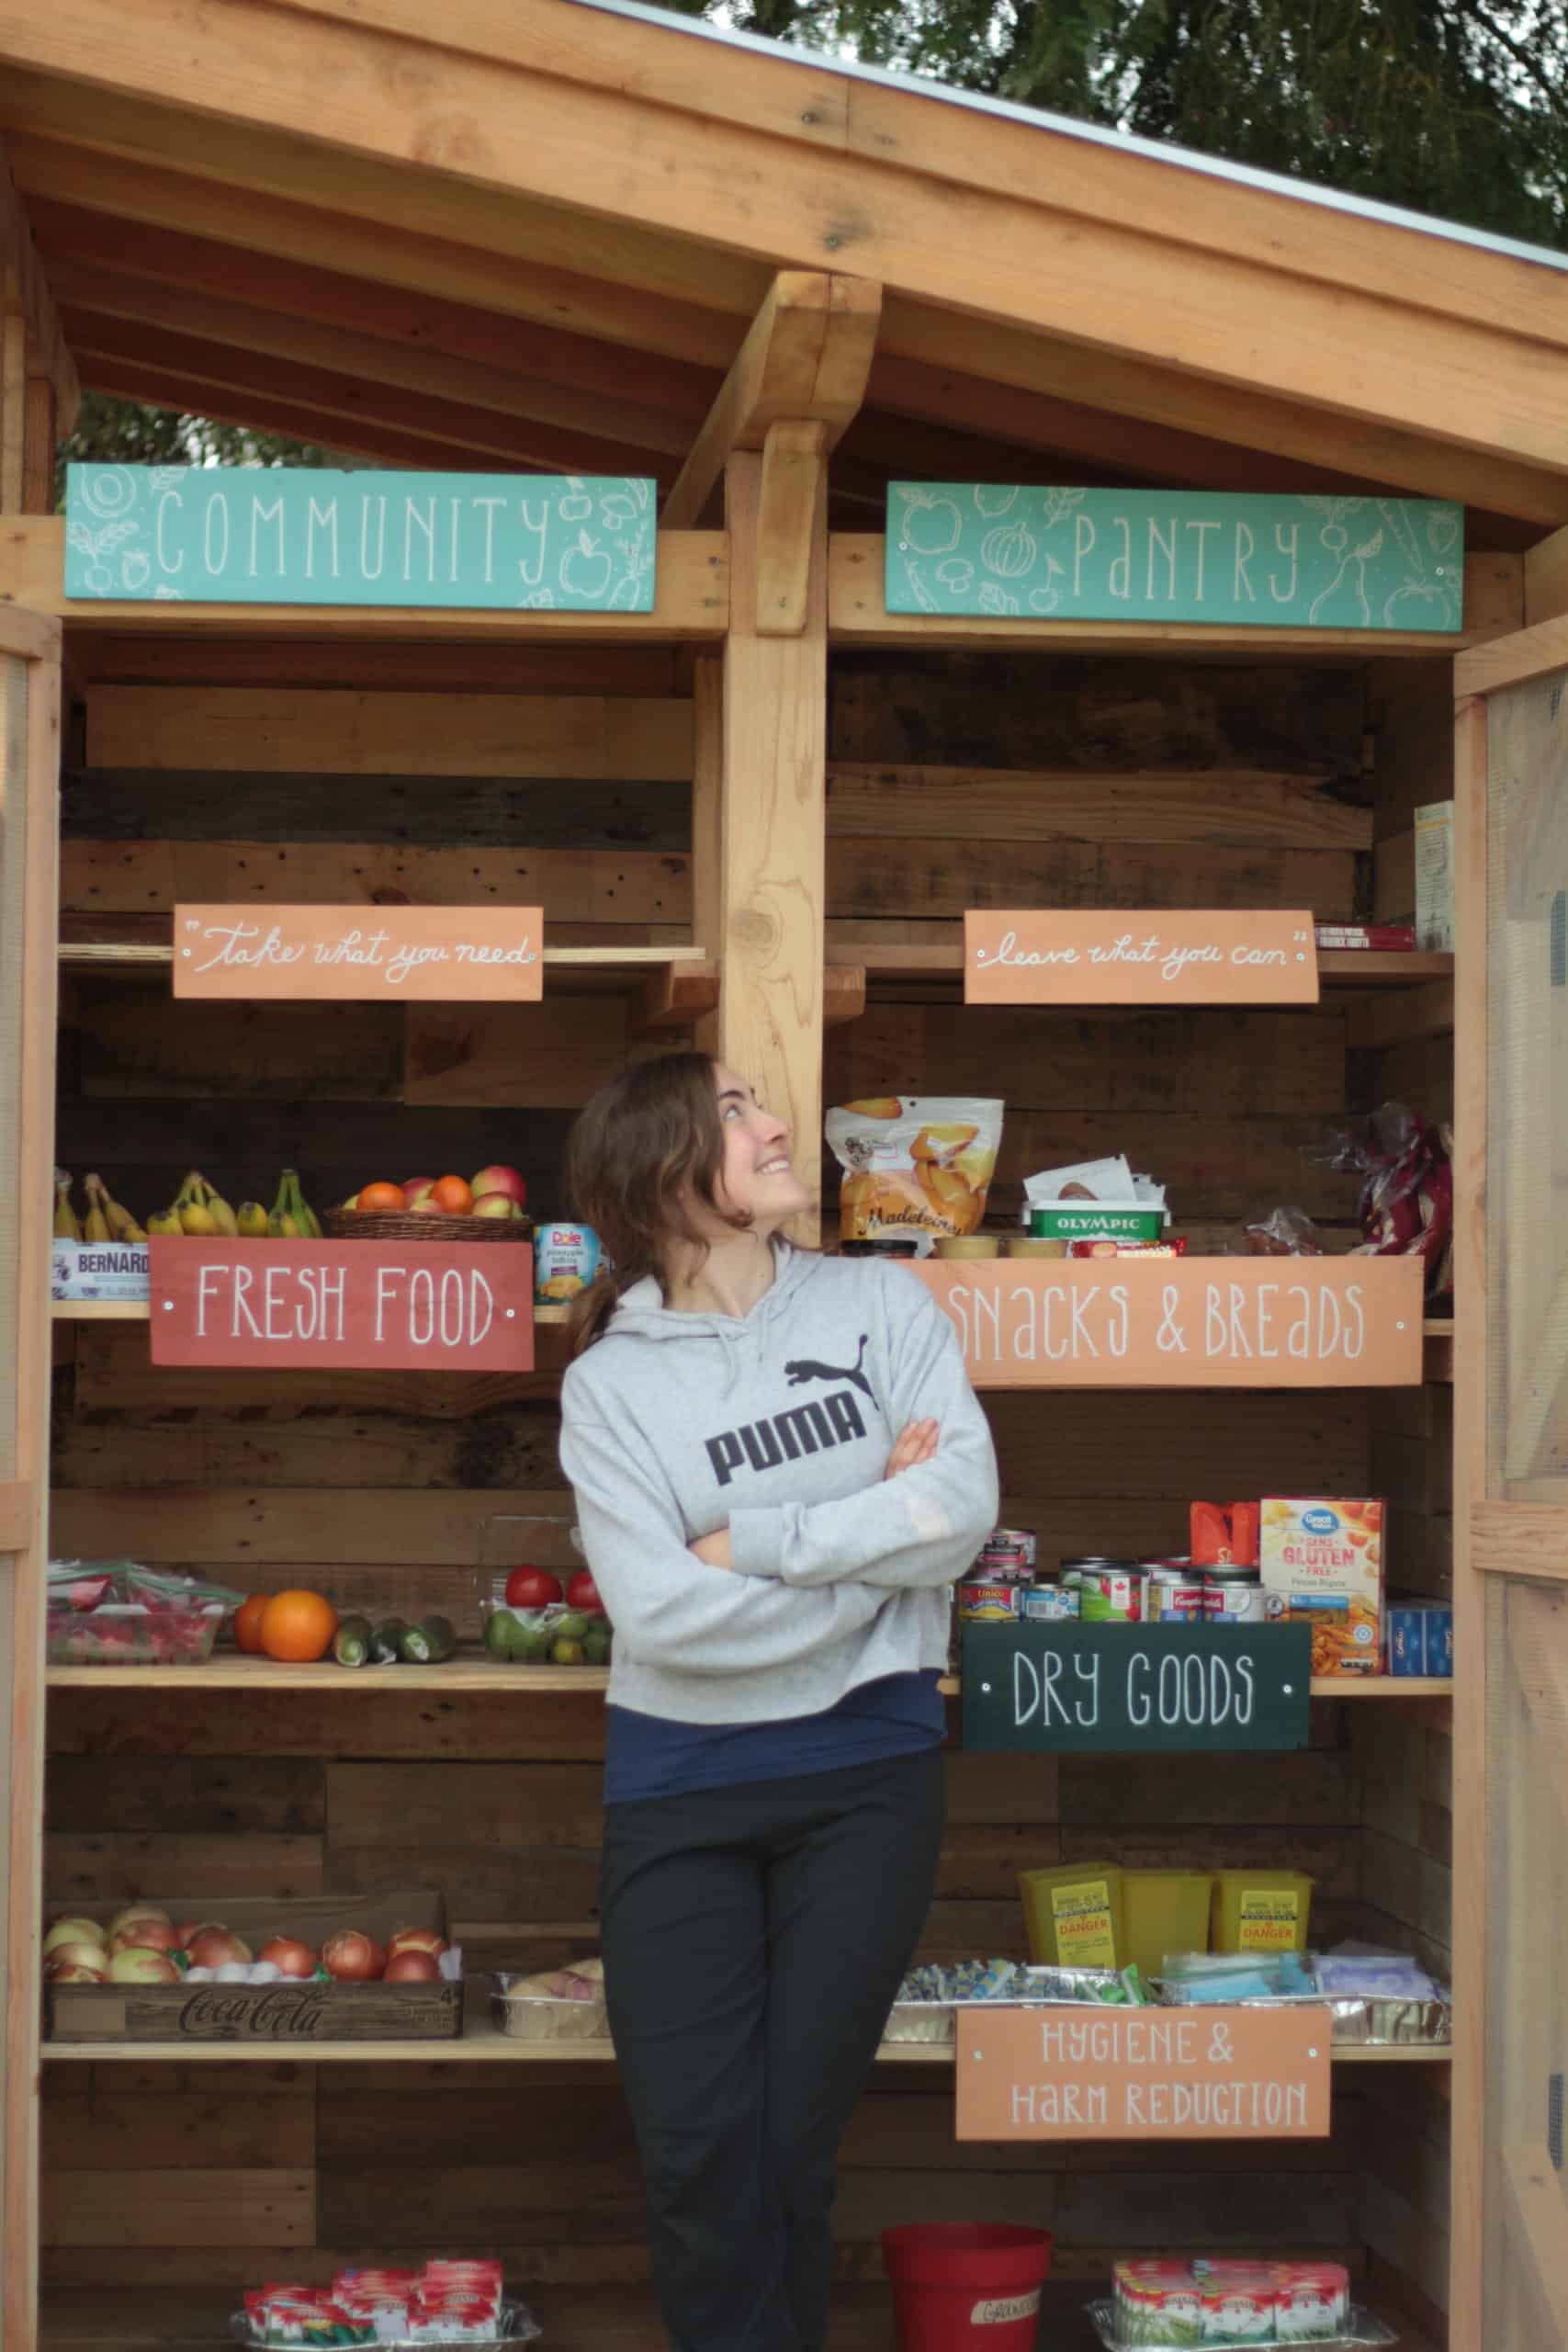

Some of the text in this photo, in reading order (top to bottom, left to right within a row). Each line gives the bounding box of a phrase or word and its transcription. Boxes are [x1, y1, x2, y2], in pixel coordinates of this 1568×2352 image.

[156, 490, 551, 585] COMMUNITY
[314, 930, 389, 964] what
[386, 944, 448, 984] you
[456, 935, 532, 965] need
[977, 931, 1080, 967] leave
[1088, 933, 1160, 964] what
[1160, 944, 1223, 981] you
[1057, 1216, 1140, 1229] OLYMPIC
[197, 1264, 493, 1346] FRESH FOOD
[1156, 1285, 1190, 1354] &
[705, 1390, 867, 1487] PUMA
[1283, 1546, 1355, 1566] GLUTEN
[1014, 1651, 1255, 1726] DRY GOODS
[1060, 1918, 1108, 1935] DANGER
[1243, 1927, 1293, 1939] DANGER
[1041, 2021, 1235, 2064] HYGIENE &
[1126, 2082, 1308, 2127] REDUCTION
